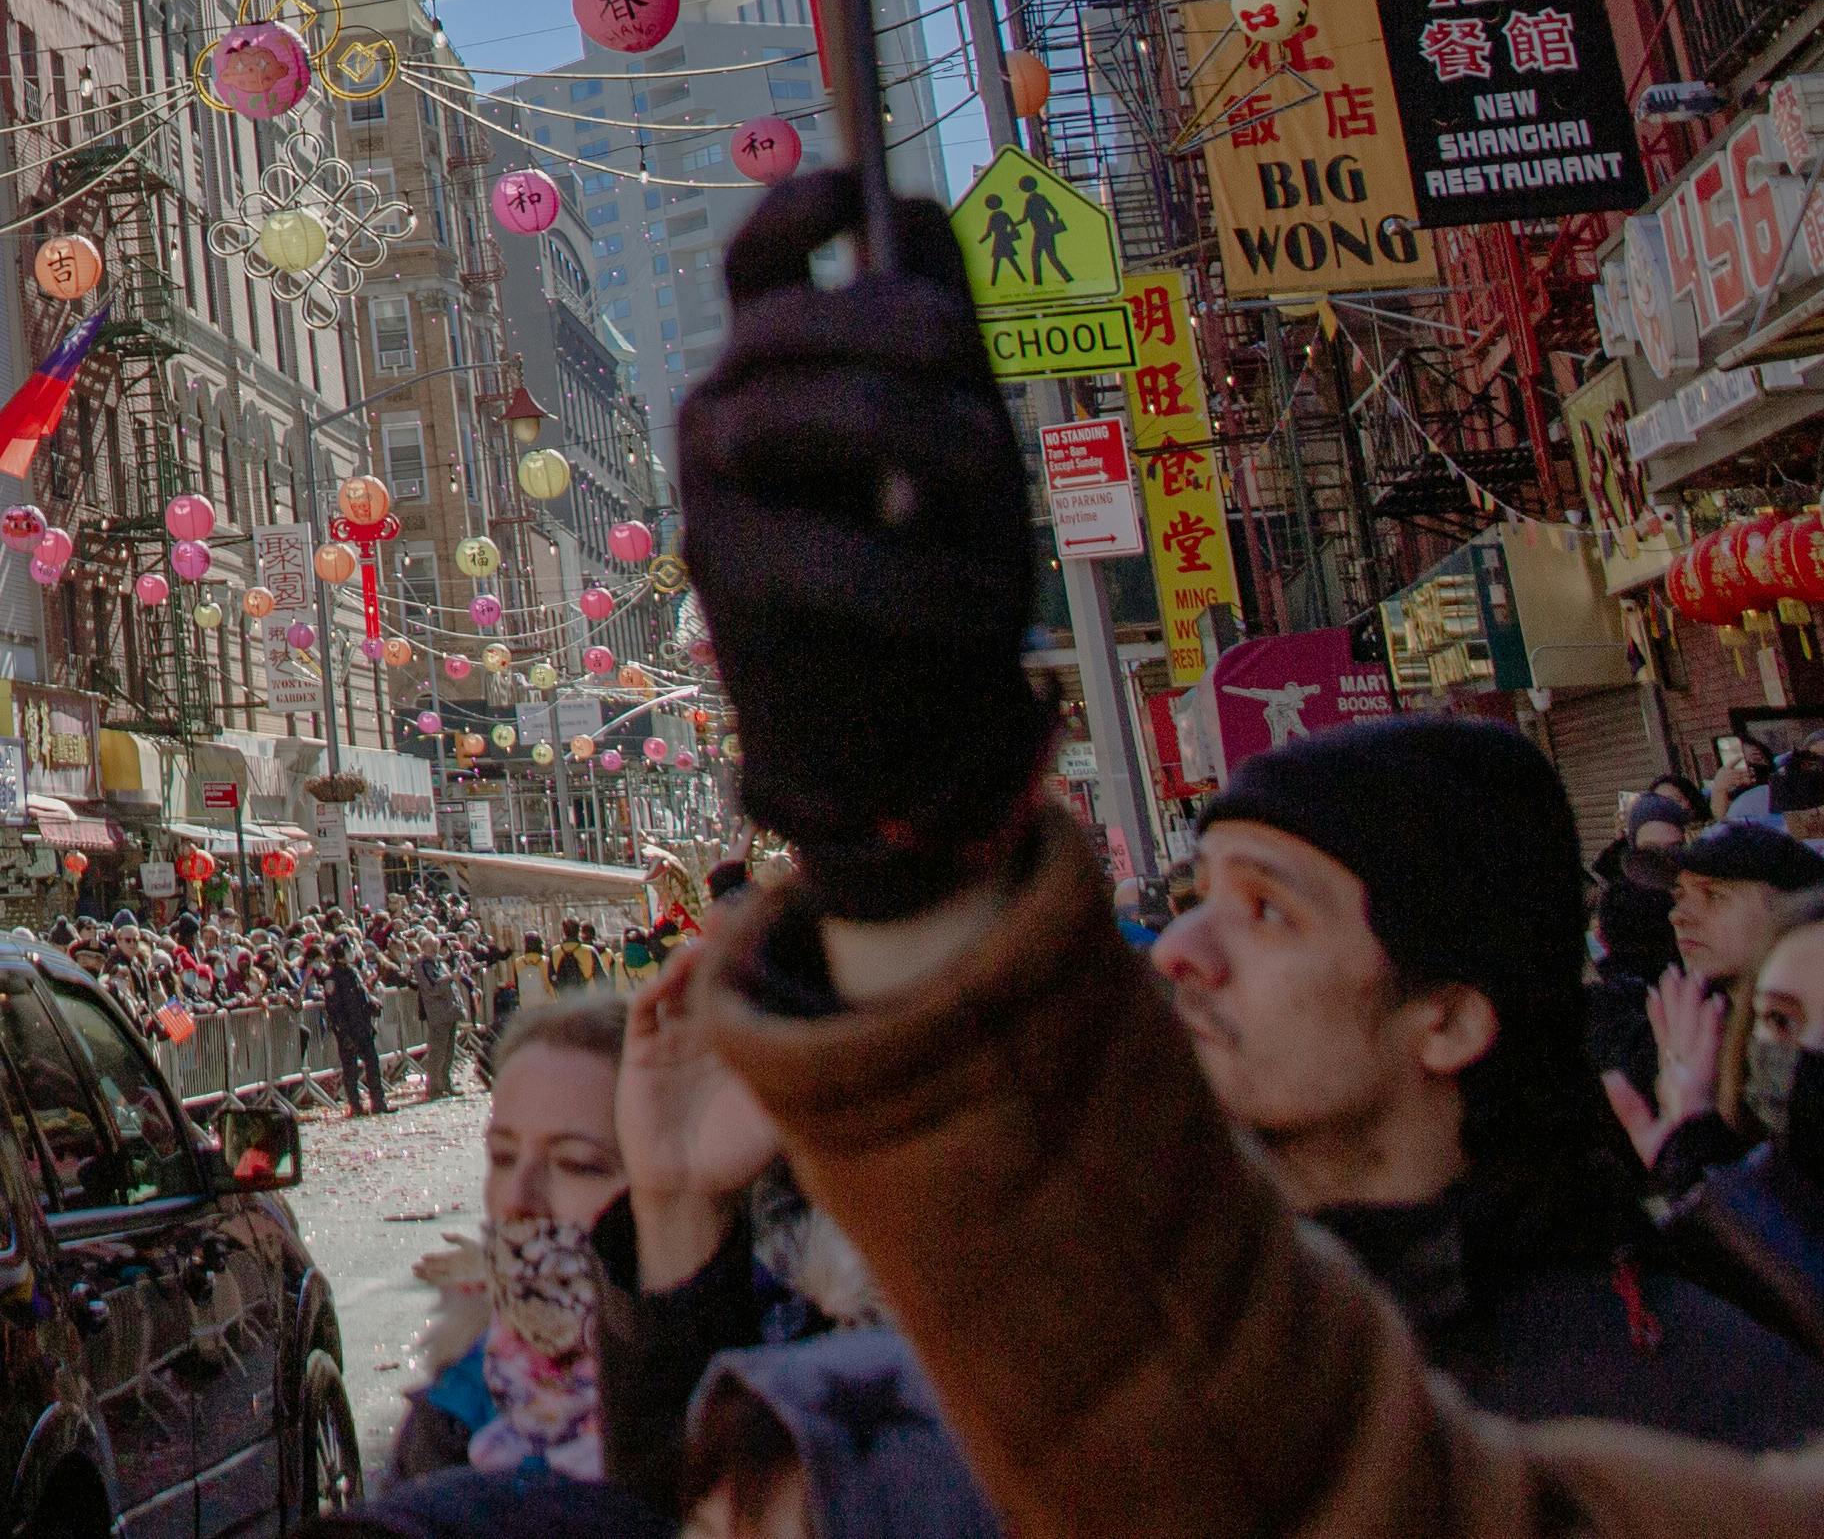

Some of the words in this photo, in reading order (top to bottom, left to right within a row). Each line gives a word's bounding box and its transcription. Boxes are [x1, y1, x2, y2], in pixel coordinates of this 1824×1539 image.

[1418, 6, 1578, 82] 餐館
[1223, 82, 1378, 149] 飯店
[1473, 88, 1541, 121] NEW
[740, 132, 775, 161] 和
[1437, 119, 1593, 161] SHANGHAI
[1256, 153, 1369, 211] BIG
[1424, 151, 1624, 199] RESTAURANT
[509, 185, 542, 214] 和
[1233, 212, 1422, 277] WONG
[1657, 126, 1787, 337] 456
[48, 249, 74, 285] 吉
[992, 321, 1123, 361] CHOOL
[1045, 430, 1060, 446] NO
[1061, 425, 1110, 445] STANDING
[1073, 456, 1104, 471] Sunday
[1055, 496, 1071, 510] NO
[1072, 491, 1114, 507] PARKING
[1058, 511, 1098, 526] Anytime
[1174, 587, 1218, 610] MING
[276, 692, 317, 703] GARDEN
[1066, 768, 1098, 776] LIQUO
[1067, 759, 1091, 768] WINE
